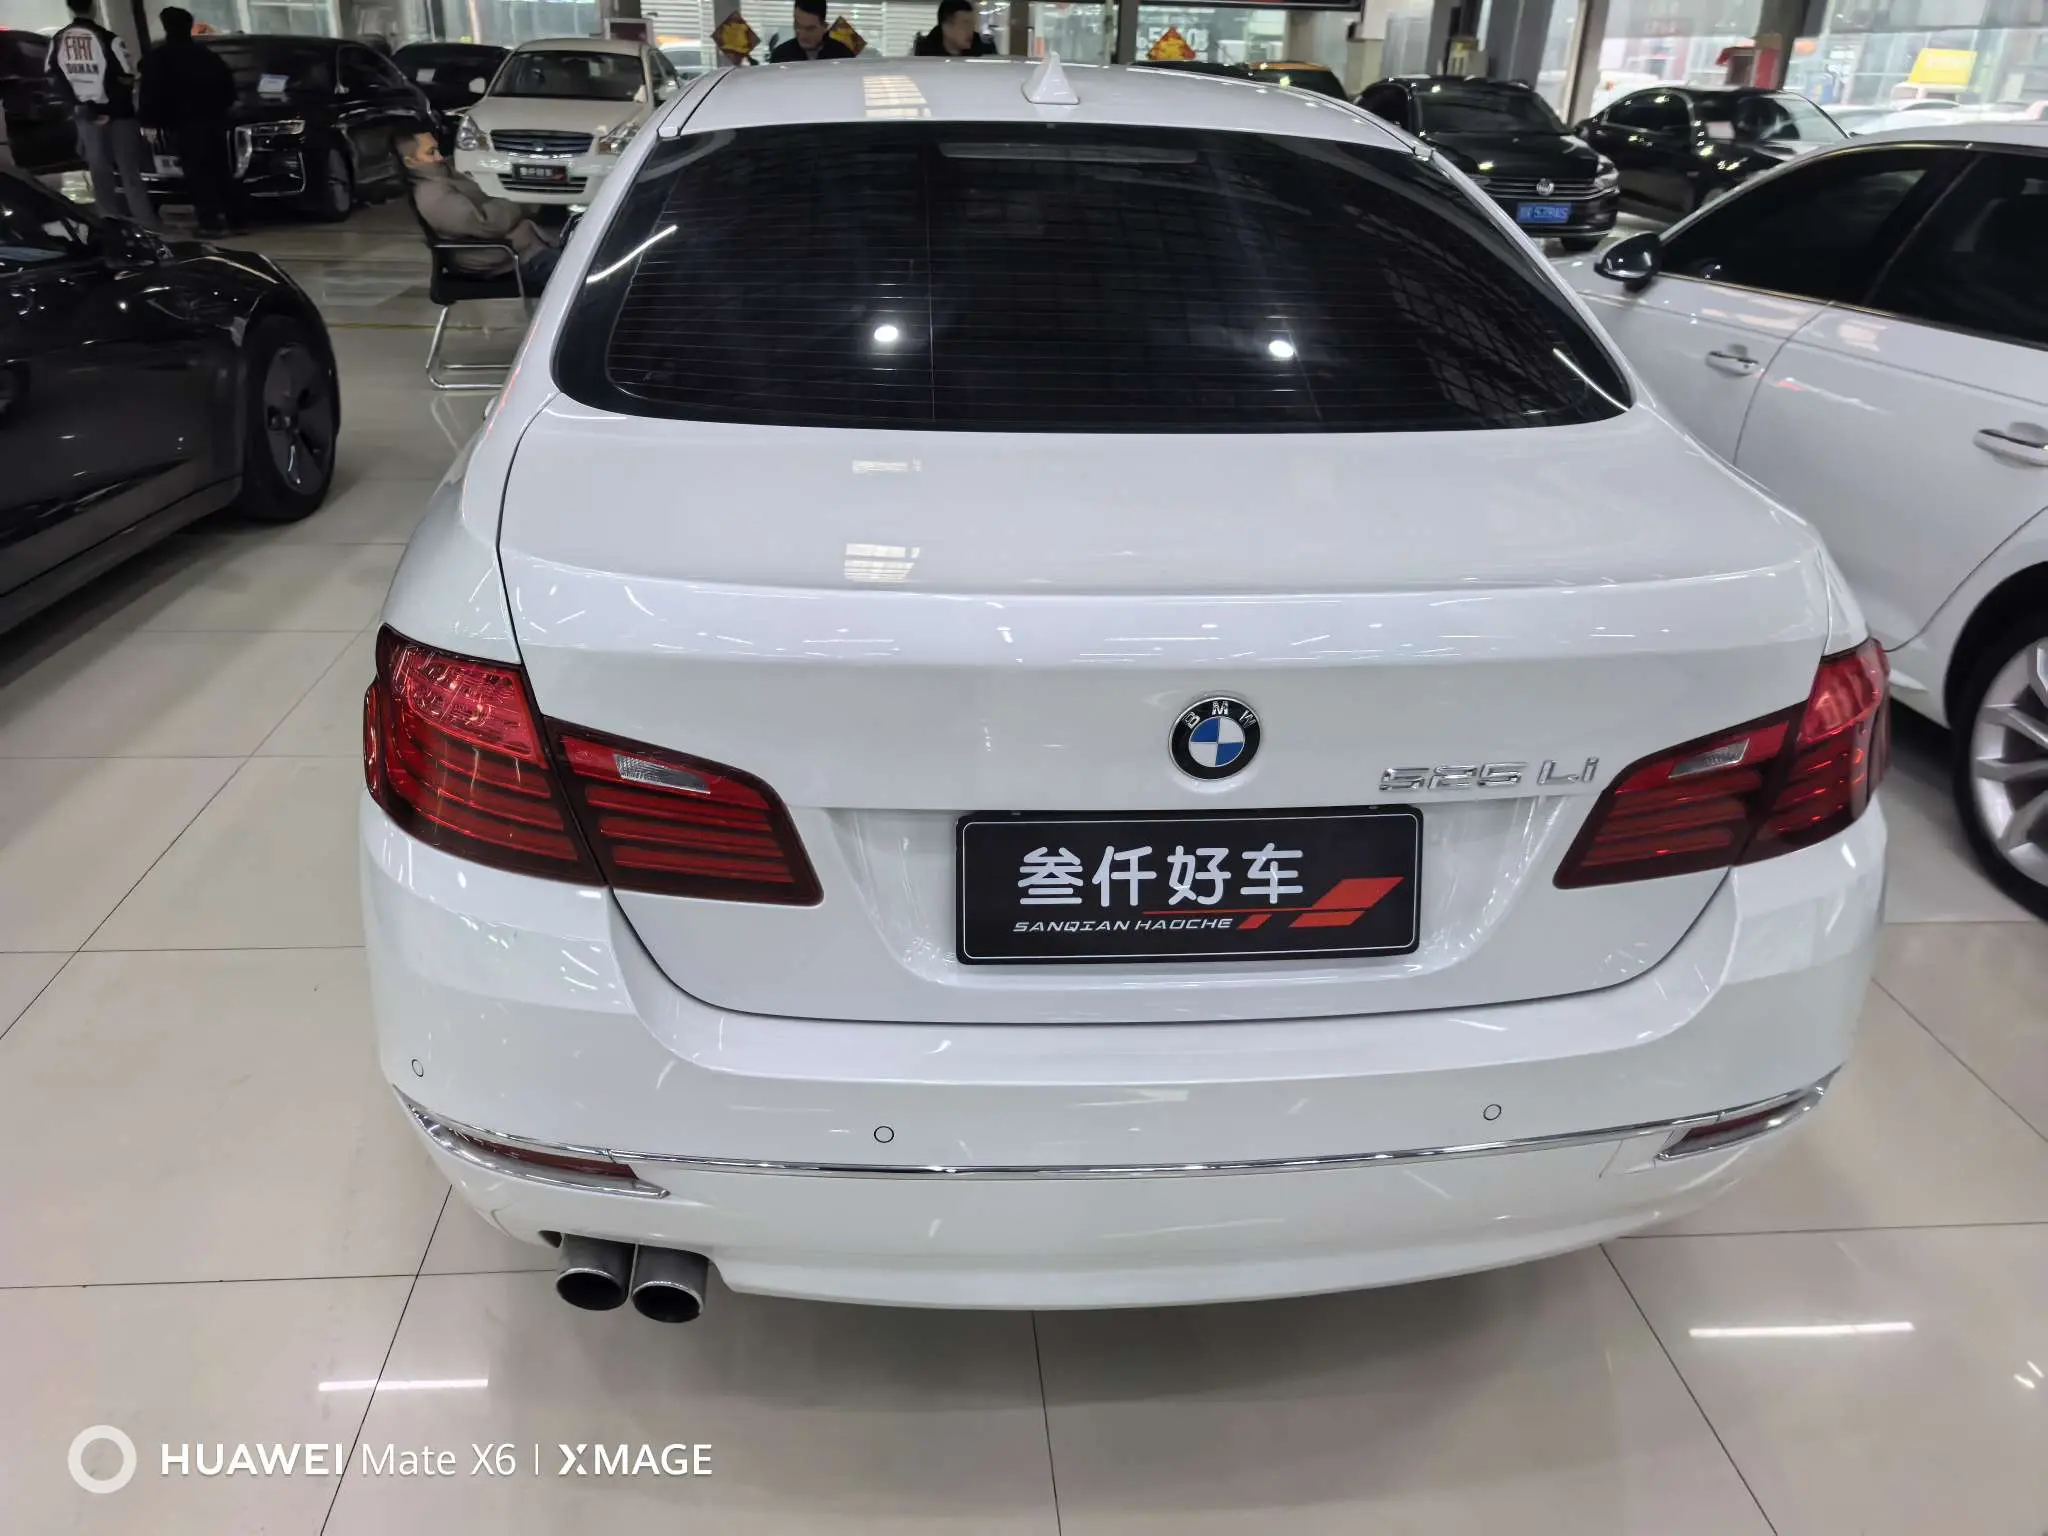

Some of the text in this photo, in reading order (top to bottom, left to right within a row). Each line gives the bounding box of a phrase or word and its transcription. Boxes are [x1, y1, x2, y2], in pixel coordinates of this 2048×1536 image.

[1184, 701, 1256, 729] BMW
[1017, 843, 1304, 907] 叁仟好车
[1012, 918, 1233, 932] SANQIAN HAOCHE
